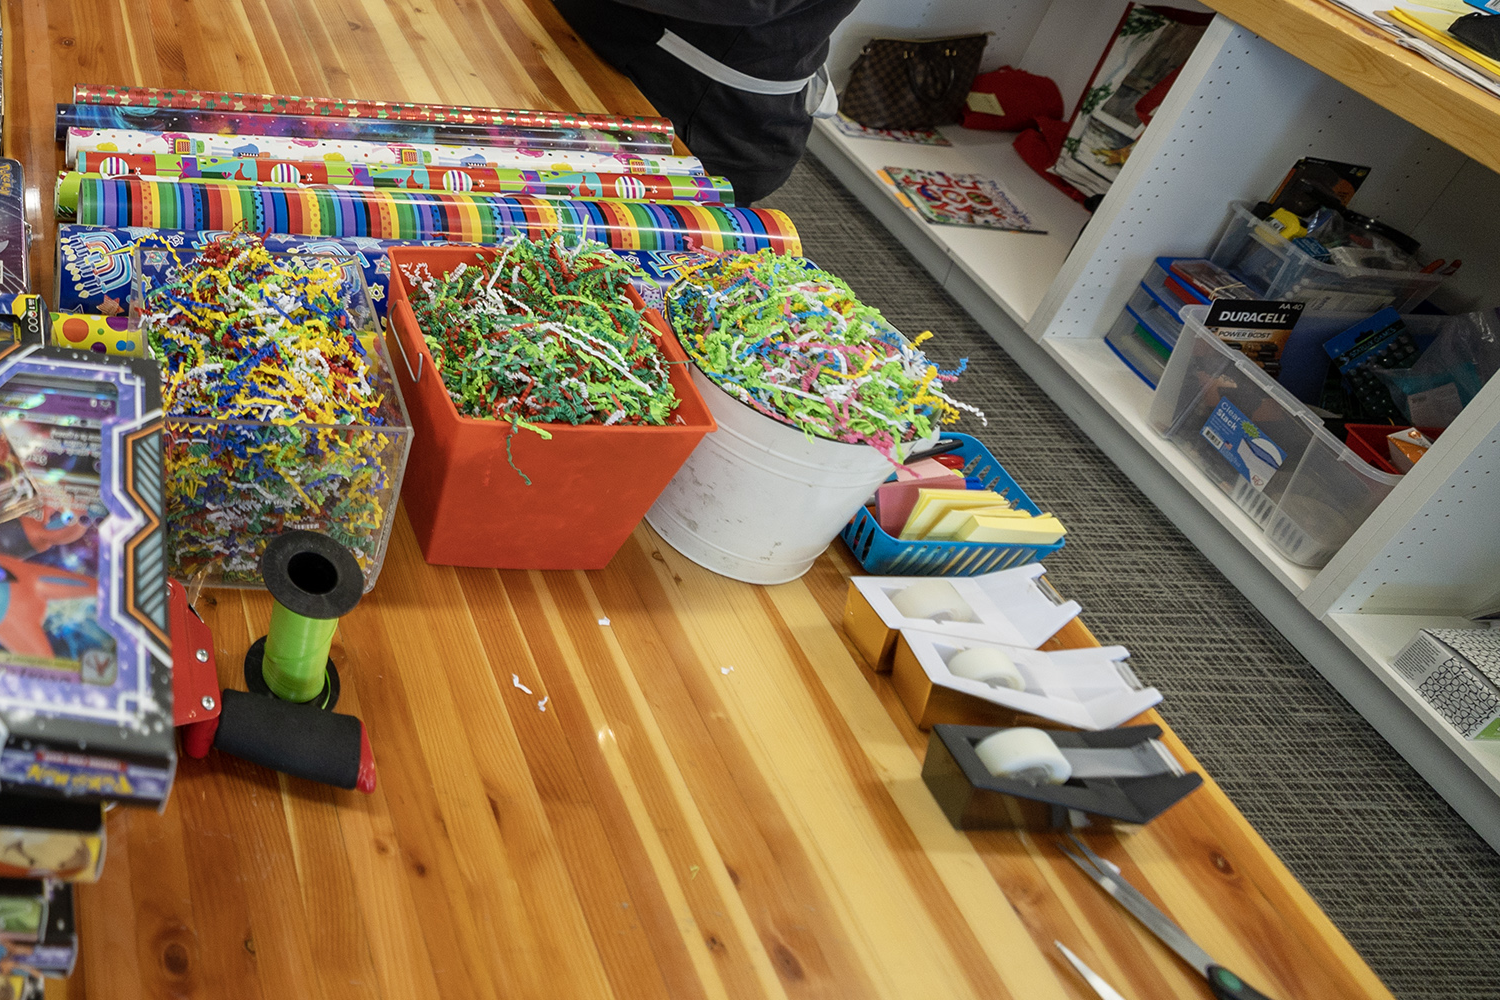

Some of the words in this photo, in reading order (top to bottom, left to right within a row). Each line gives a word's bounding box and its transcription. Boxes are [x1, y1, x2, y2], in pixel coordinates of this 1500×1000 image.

[1292, 303, 1304, 311] 40
[1217, 311, 1287, 324] DURACELL
[1217, 331, 1248, 339] POWER
[1247, 331, 1272, 339] BOOST
[1219, 401, 1242, 422] Clear
[1215, 409, 1238, 432] Stack
